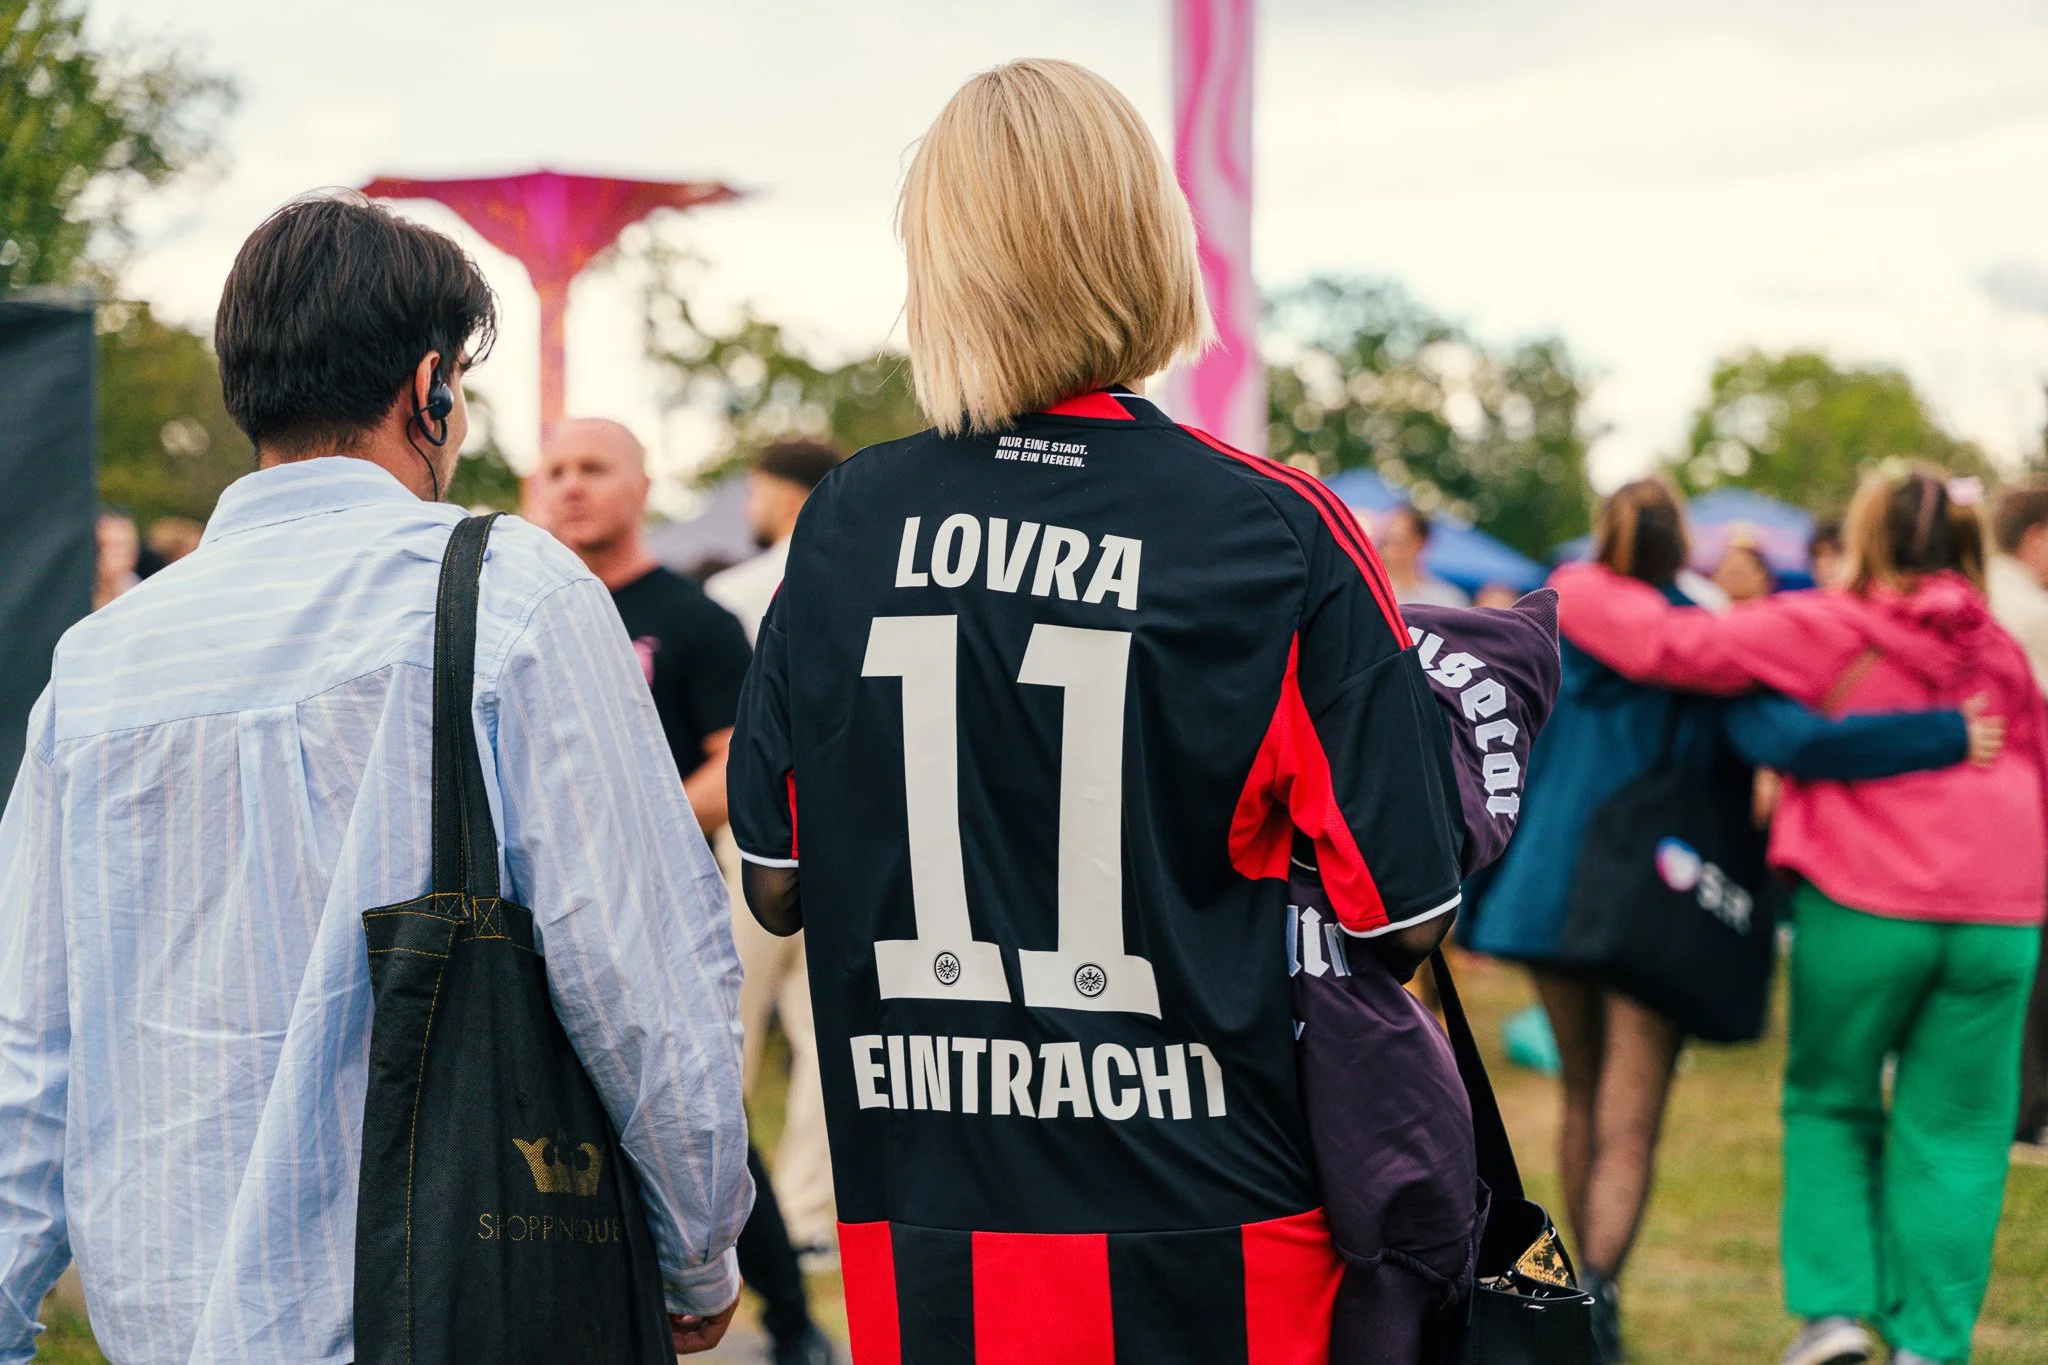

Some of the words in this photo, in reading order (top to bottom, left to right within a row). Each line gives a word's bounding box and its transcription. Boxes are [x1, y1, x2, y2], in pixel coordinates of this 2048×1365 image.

[994, 449, 1020, 461] NUR
[1020, 451, 1040, 462] EIN
[1041, 453, 1085, 467] VEREIN.
[998, 436, 1023, 448] NUR
[1023, 438, 1050, 451] EINE
[1050, 442, 1088, 455] STADT.
[894, 513, 1143, 611] LOVRA
[860, 614, 1163, 1020] 11
[849, 1034, 1227, 1121] EINTRACHT
